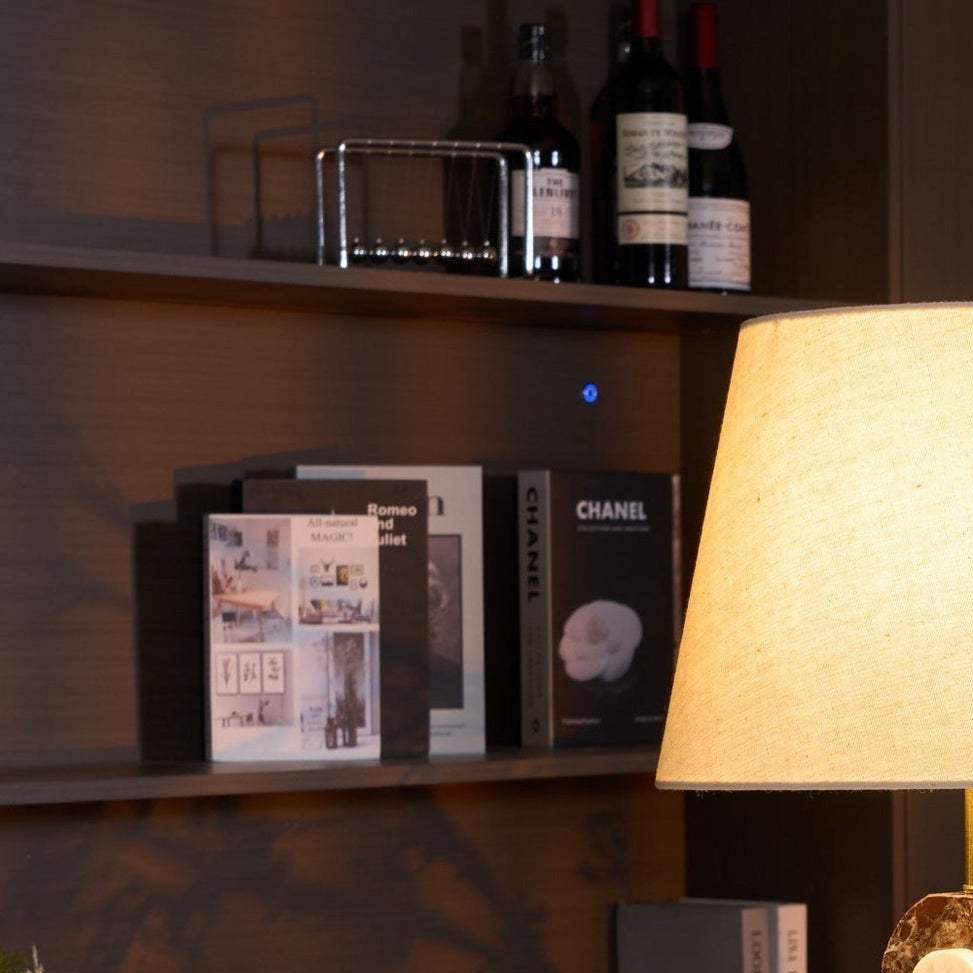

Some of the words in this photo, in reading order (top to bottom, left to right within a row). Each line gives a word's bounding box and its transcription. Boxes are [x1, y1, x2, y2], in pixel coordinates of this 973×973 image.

[367, 503, 417, 517] Romeo
[576, 501, 646, 520] CHANEL
[378, 518, 394, 530] nd
[378, 533, 407, 546] uliet
[527, 487, 540, 603] CHANEL
